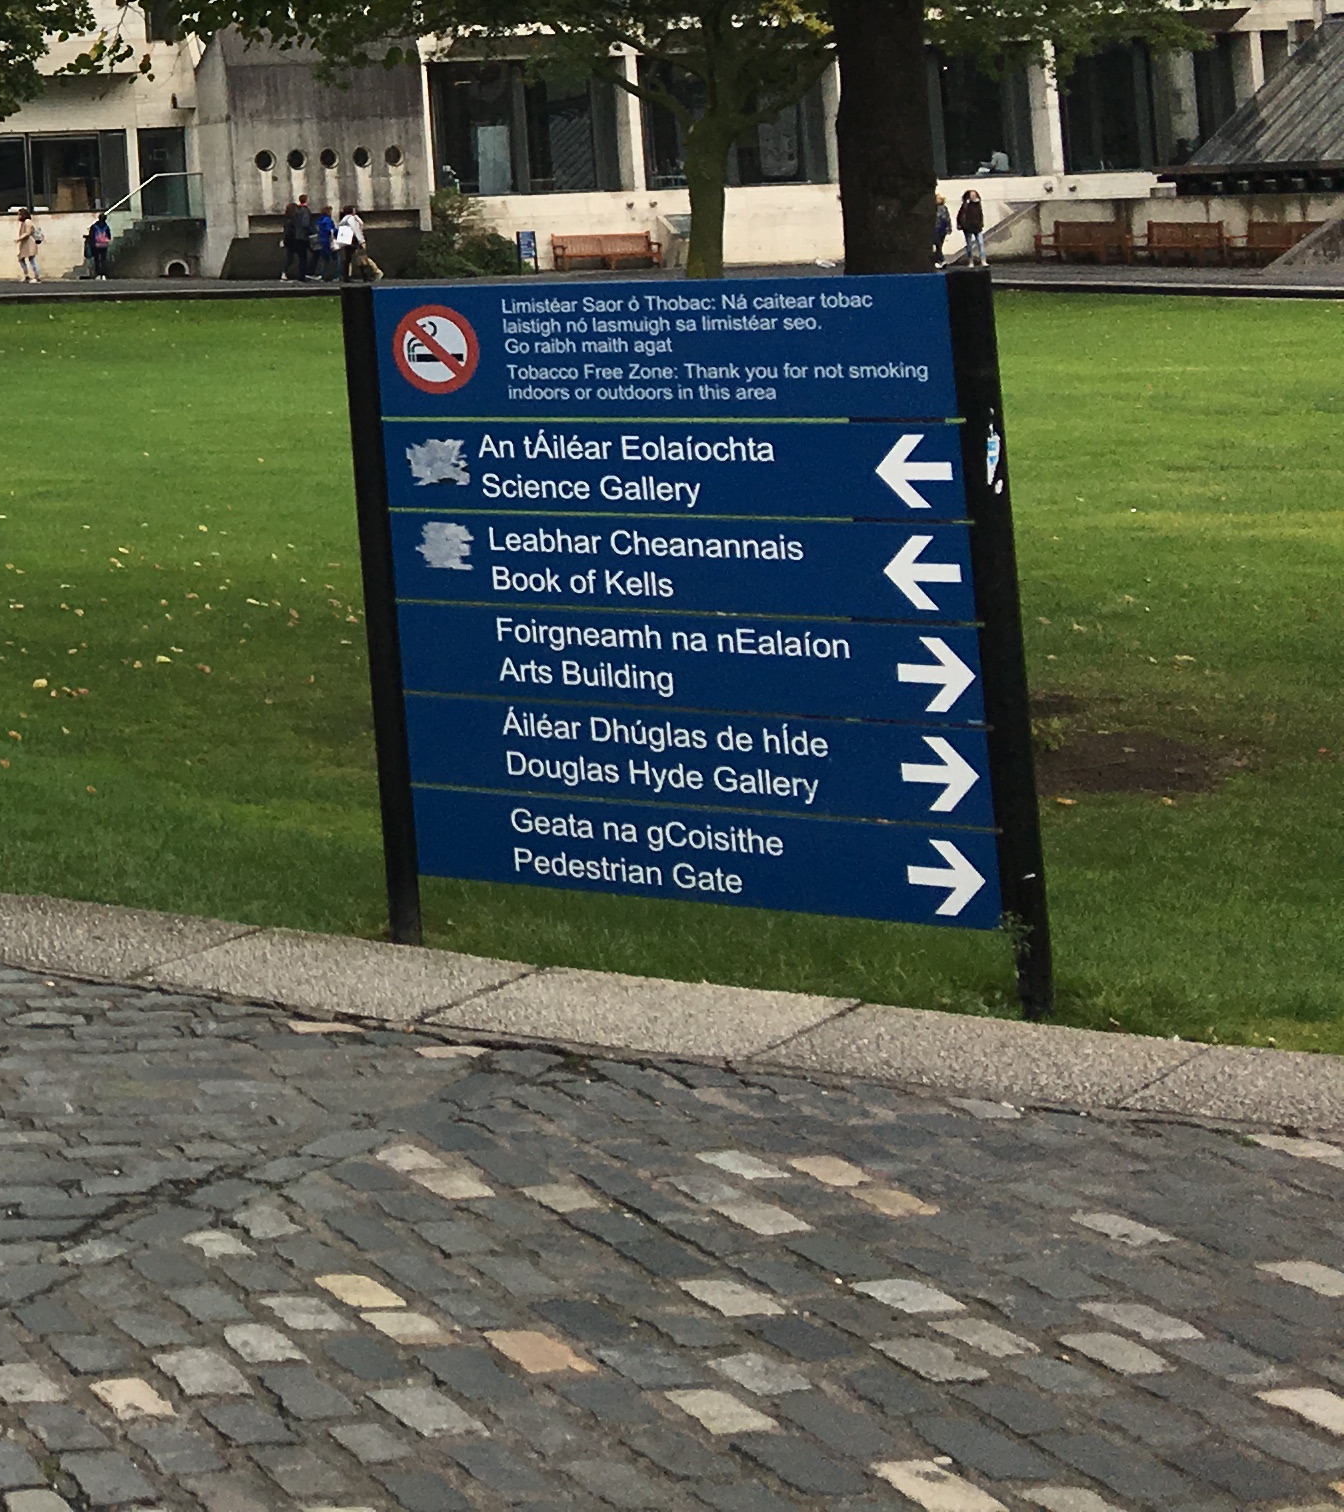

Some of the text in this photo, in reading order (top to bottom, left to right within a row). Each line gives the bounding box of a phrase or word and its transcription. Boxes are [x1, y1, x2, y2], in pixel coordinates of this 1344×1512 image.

[501, 291, 873, 314] Limistéar Saor ó Thobac: Ná caitear tobac
[502, 314, 822, 338] laistigh nó lasmuigh sa limistéar seo.
[504, 336, 673, 357] Go raibh maith agat
[506, 361, 929, 383] Tobacco Free Zone: Thank you for not smoking
[508, 383, 777, 401] indoors or outdoors in this area
[478, 428, 775, 462] An tÁiléar Eolaíochta
[482, 472, 701, 508] Science Gallery
[488, 526, 804, 561] Leabhar Cheanannais
[491, 565, 674, 598] Book of Kells
[496, 617, 851, 659] Foirgneamh na nEalaíon
[499, 656, 674, 698] Arts Building
[502, 705, 829, 758] Áiléar Dhúglas de hÍde
[506, 750, 819, 805] Douglas Hyde Gallery
[510, 807, 784, 857] Geata na gCoisithe
[513, 847, 743, 894] Pedestrian Gate
